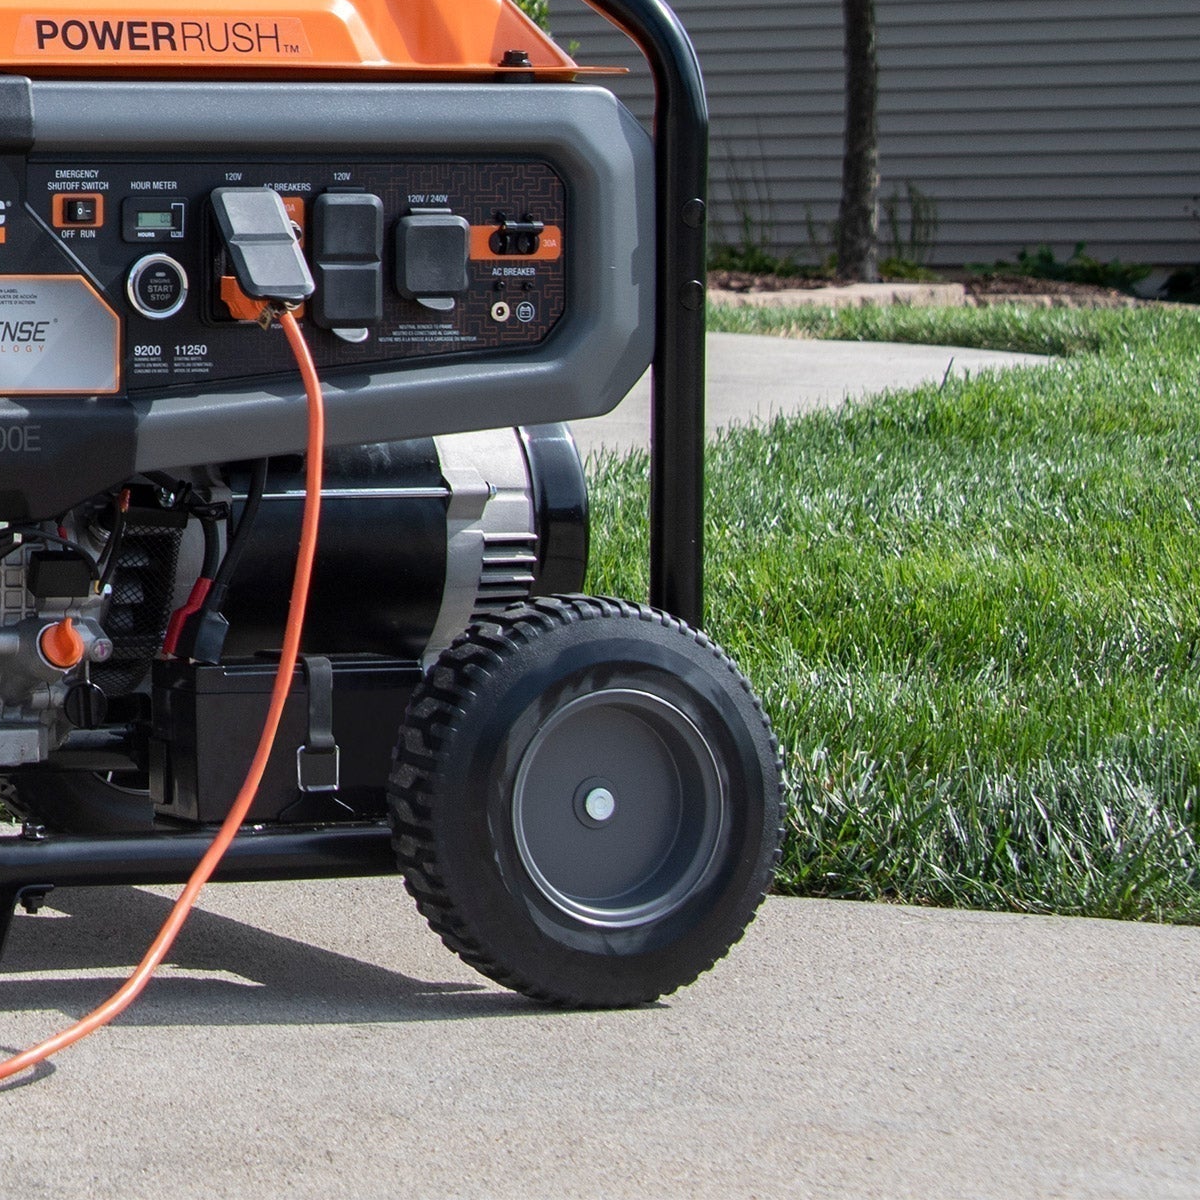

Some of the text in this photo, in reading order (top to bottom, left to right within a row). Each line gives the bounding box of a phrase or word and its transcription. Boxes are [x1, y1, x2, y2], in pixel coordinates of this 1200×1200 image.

[55, 169, 99, 179] EMERGENCY
[224, 172, 243, 181] 120V
[333, 172, 351, 181] 120V
[47, 181, 109, 190] SHUTOFF SWITCH
[130, 181, 178, 190] HOUR METER
[274, 183, 312, 192] BREAKERS
[407, 194, 424, 203] 120V
[430, 194, 449, 203] 240V
[61, 230, 96, 239] OFF RUN
[542, 238, 557, 248] 30A
[491, 267, 536, 276] AC BREAKER
[147, 285, 174, 293] START
[134, 345, 161, 356] 9200
[174, 344, 208, 356] 11250
